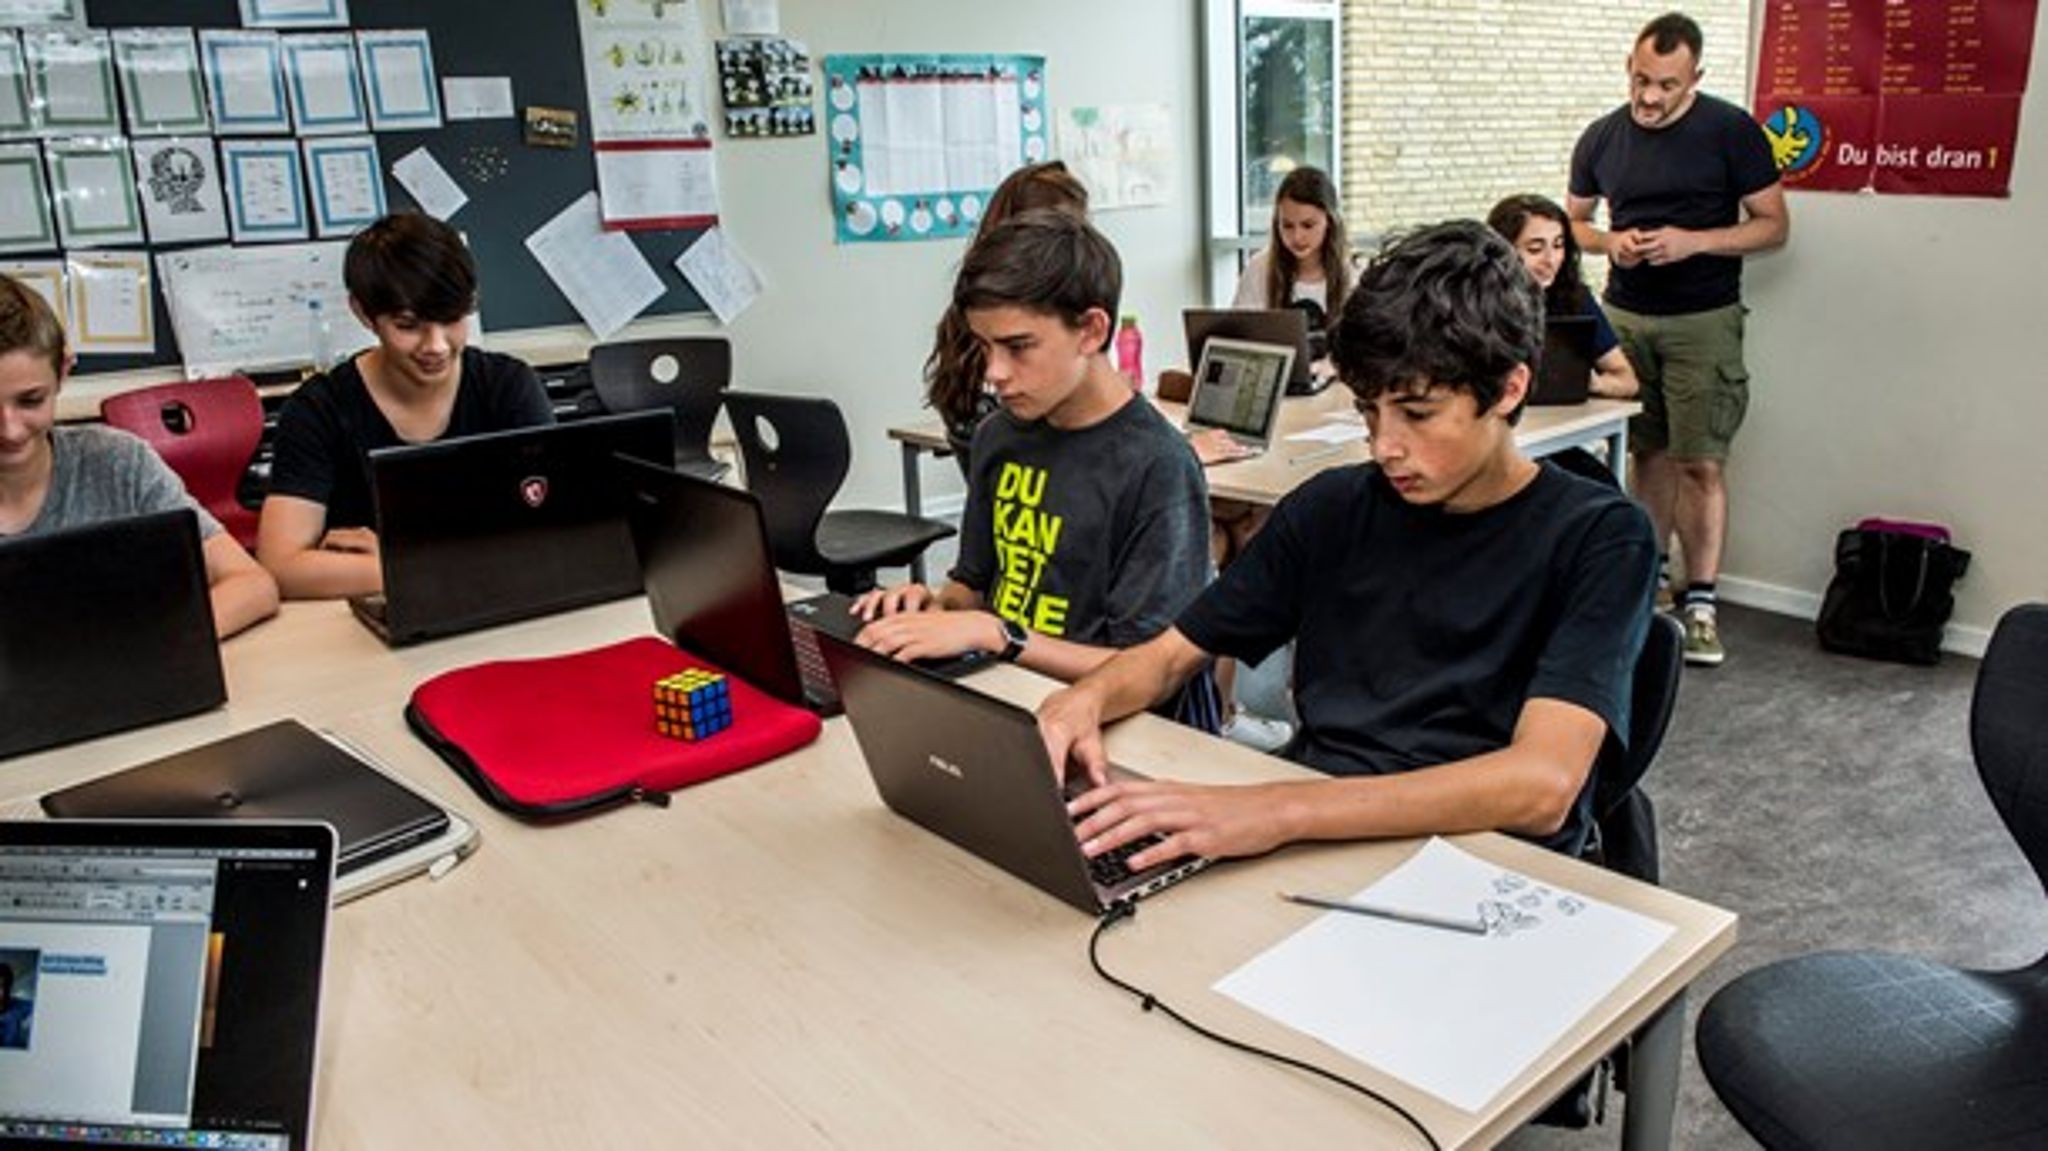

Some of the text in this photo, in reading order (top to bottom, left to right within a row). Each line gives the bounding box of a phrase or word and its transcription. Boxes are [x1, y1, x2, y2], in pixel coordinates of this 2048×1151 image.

[1837, 142, 1867, 166] Du
[1876, 144, 1917, 167] bist
[1926, 146, 1982, 169] dran
[1988, 146, 1998, 170] 1
[997, 462, 1047, 507] DU
[994, 500, 1063, 555] KAN
